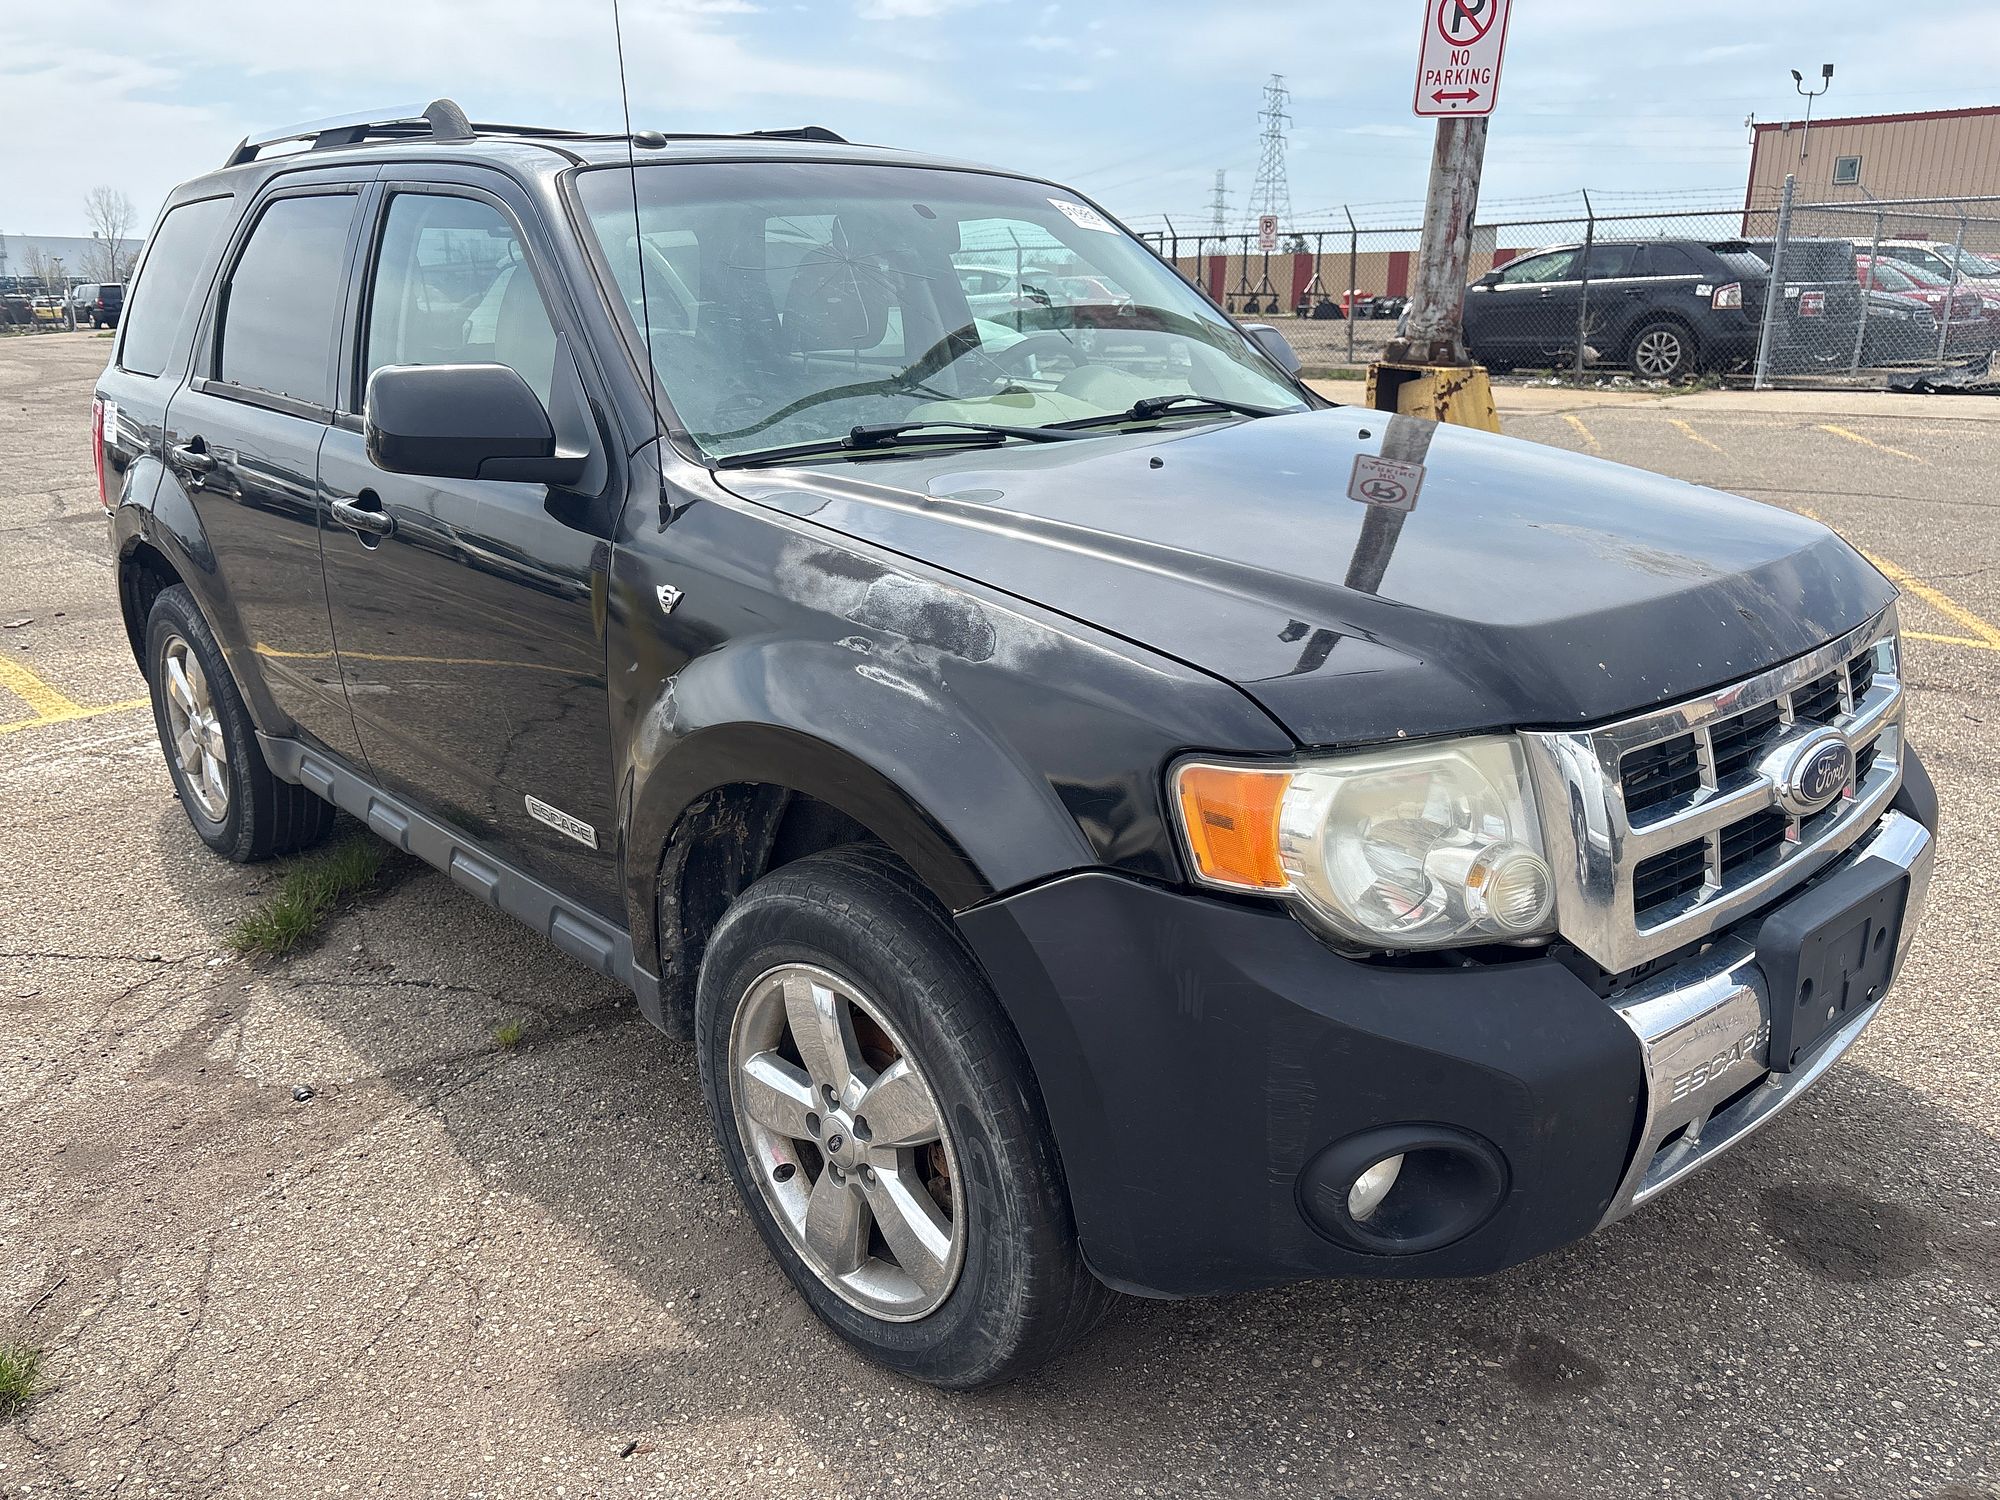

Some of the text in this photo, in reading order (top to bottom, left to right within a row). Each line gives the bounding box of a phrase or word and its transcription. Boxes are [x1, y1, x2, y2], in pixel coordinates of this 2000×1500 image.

[1425, 68, 1491, 86] PARKING
[1450, 49, 1470, 66] NO
[1815, 751, 1846, 794] Ford
[529, 800, 592, 843] ESCAPE
[1670, 1019, 1770, 1103] ESCAPE
